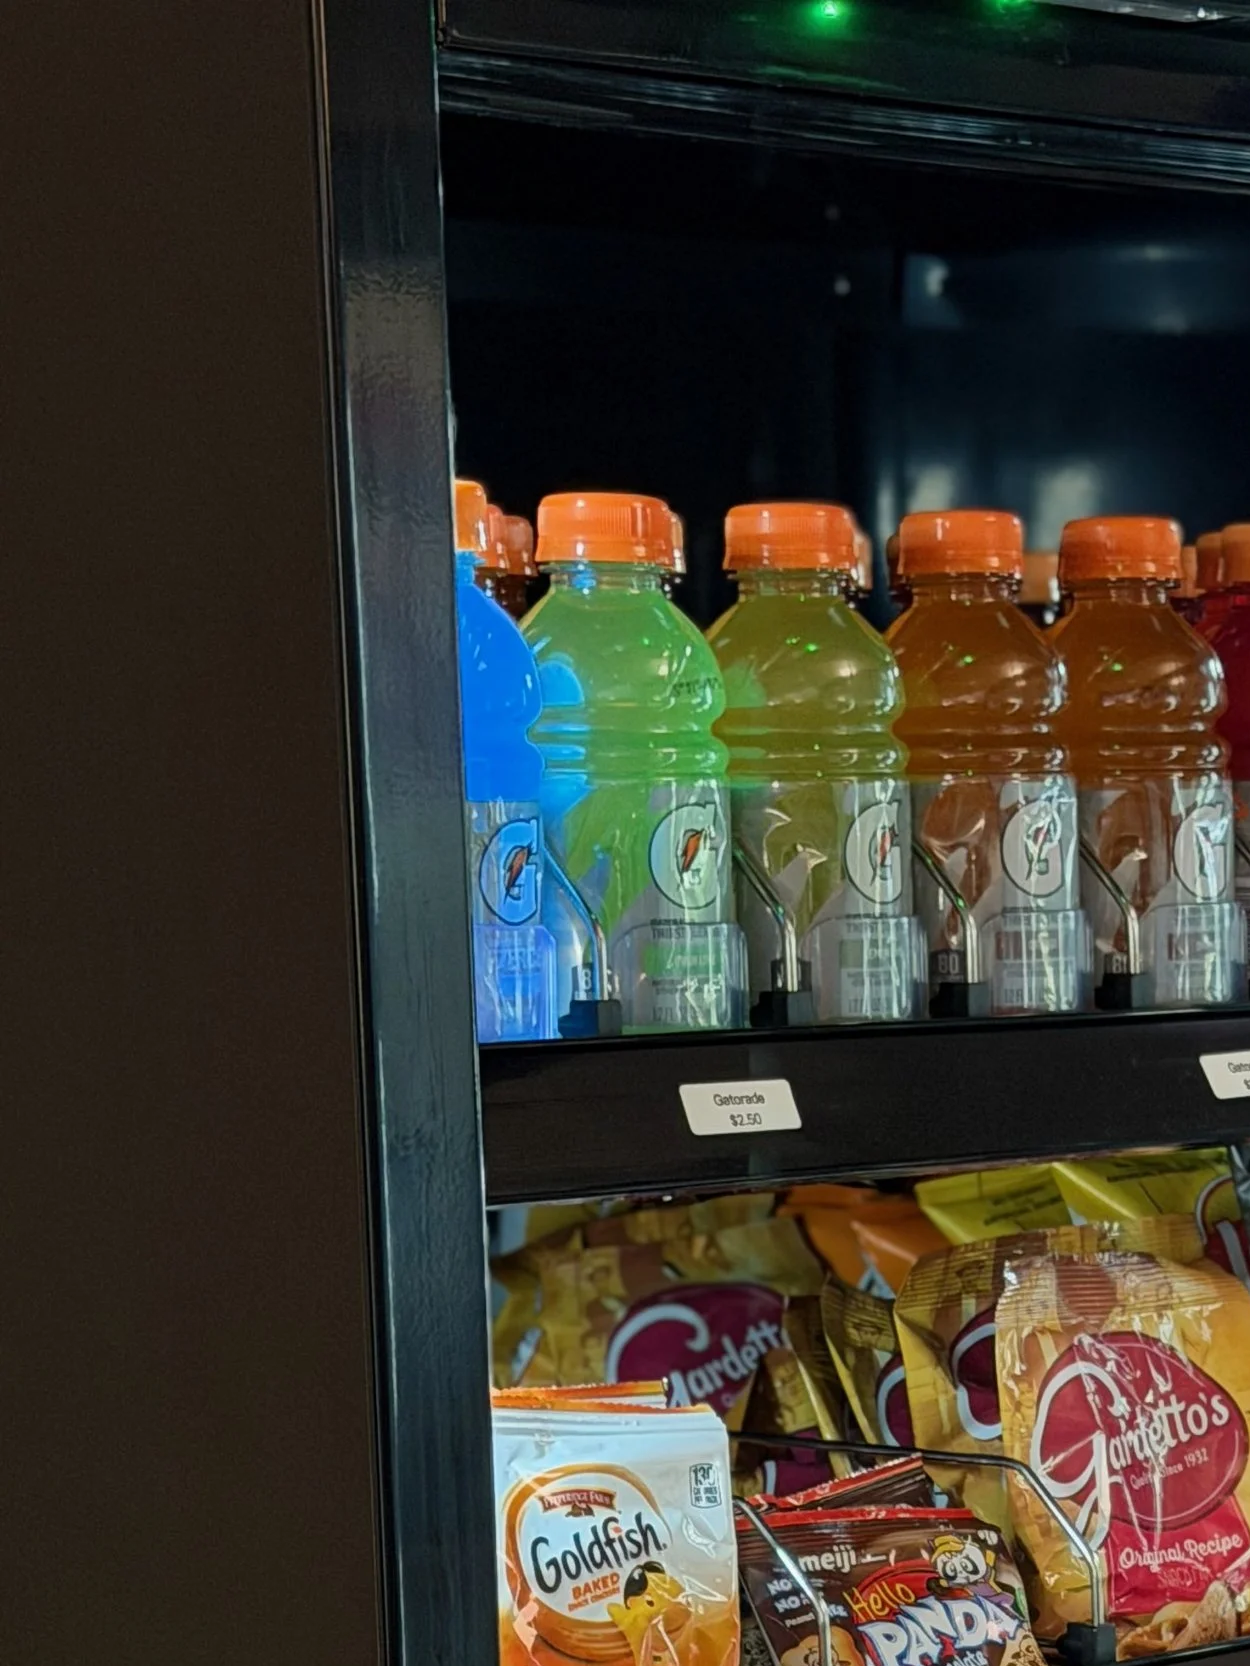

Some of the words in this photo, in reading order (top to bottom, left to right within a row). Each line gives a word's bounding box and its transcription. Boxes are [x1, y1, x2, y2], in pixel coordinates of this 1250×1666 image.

[713, 1092, 766, 1107] Gatorade
[730, 1112, 763, 1127] $2.50
[530, 1511, 664, 1595] Goldfish
[799, 1544, 857, 1573] meiji
[1119, 1543, 1186, 1573] Original
[1183, 1533, 1243, 1561] Recipe
[572, 1571, 620, 1600] BAKED
[844, 1580, 916, 1623] Hello
